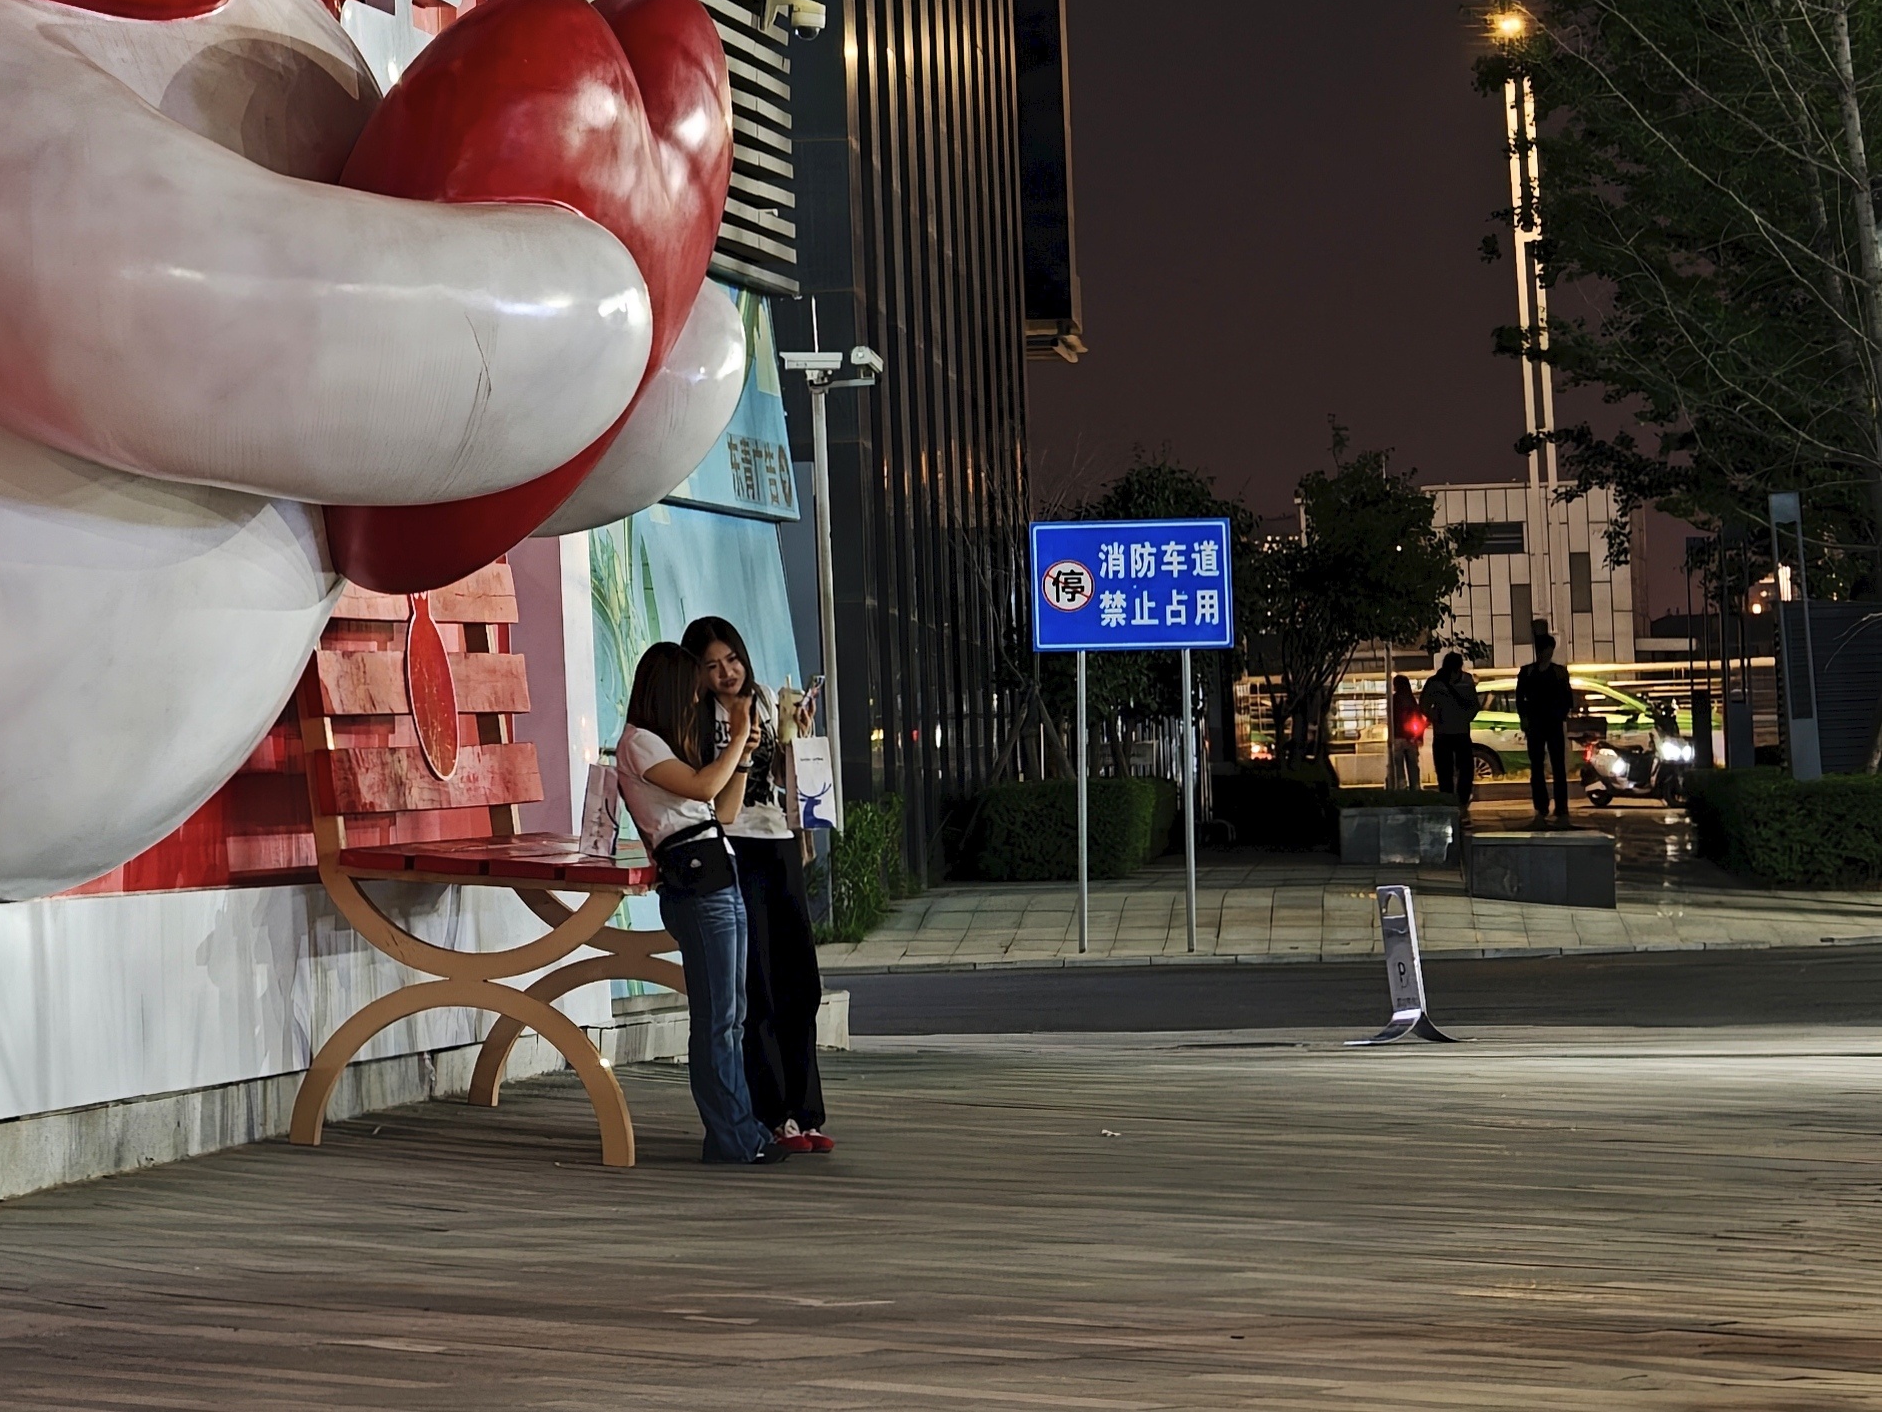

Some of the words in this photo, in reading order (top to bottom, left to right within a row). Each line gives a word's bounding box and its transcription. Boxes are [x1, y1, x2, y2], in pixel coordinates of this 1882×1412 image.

[1098, 540, 1220, 579] 消防车道
[1051, 569, 1085, 603] 停
[1099, 589, 1220, 628] 禁止占用
